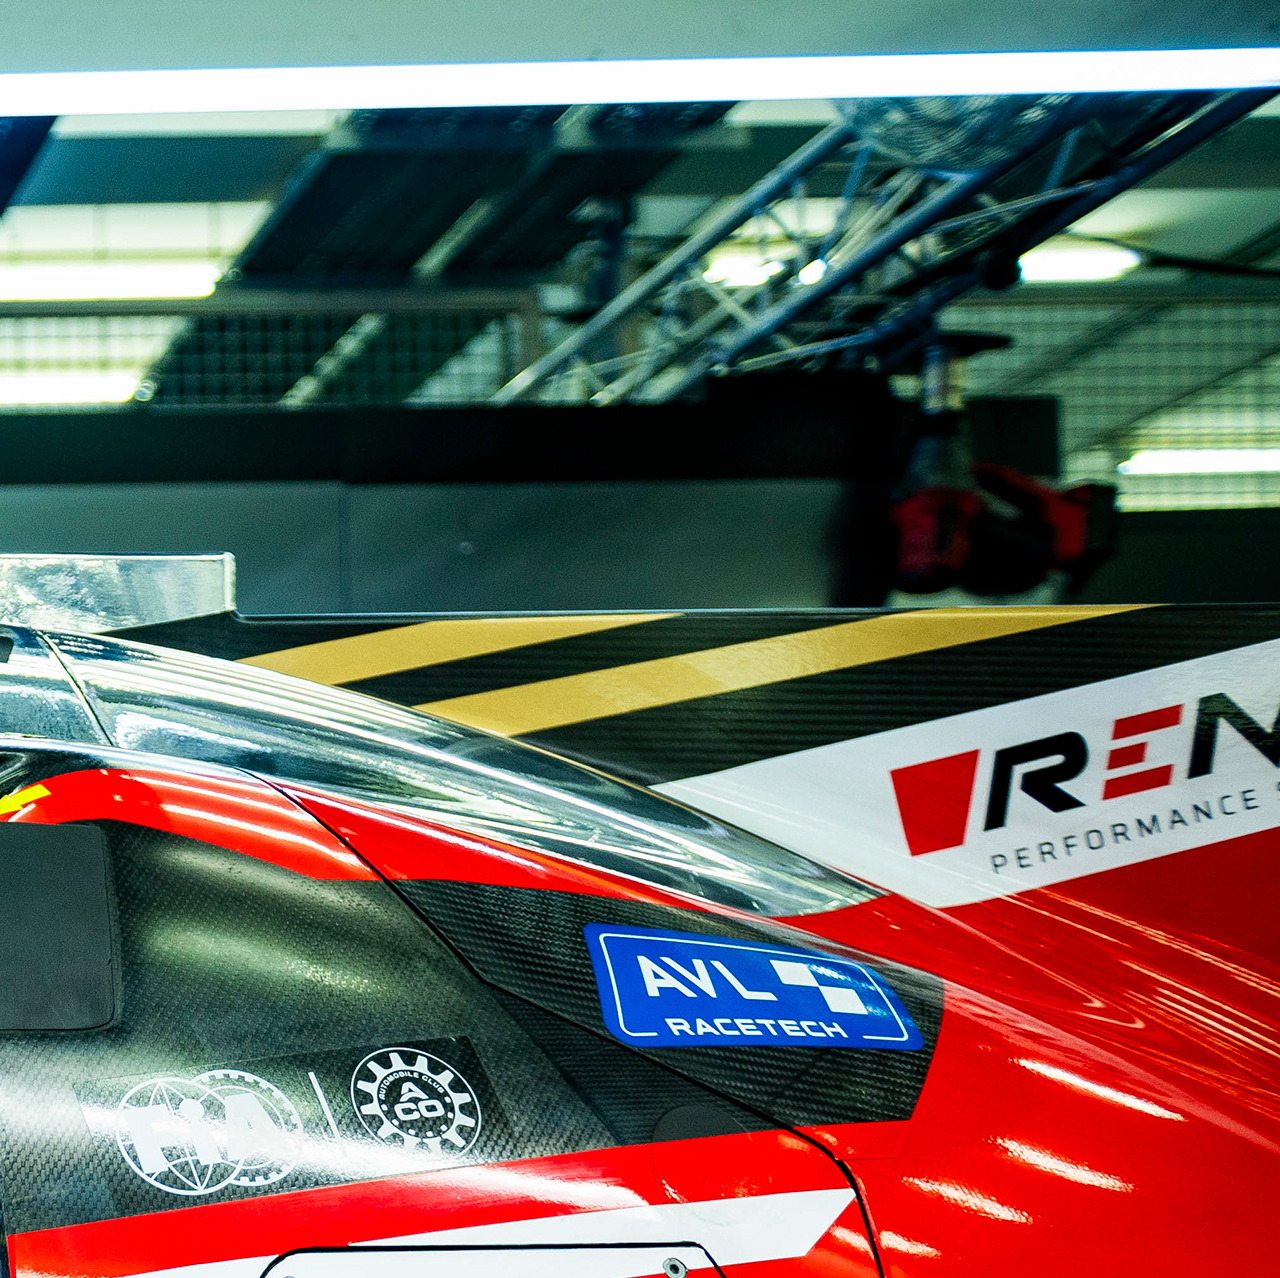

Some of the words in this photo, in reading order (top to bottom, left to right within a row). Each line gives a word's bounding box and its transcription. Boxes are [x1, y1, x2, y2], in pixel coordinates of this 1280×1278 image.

[991, 788, 1259, 875] PERFORMANCE
[636, 955, 779, 1001] AVL
[664, 1017, 849, 1039] RACETECH
[378, 1071, 420, 1101] AUTOMOBILE
[421, 1075, 445, 1094] CLUB
